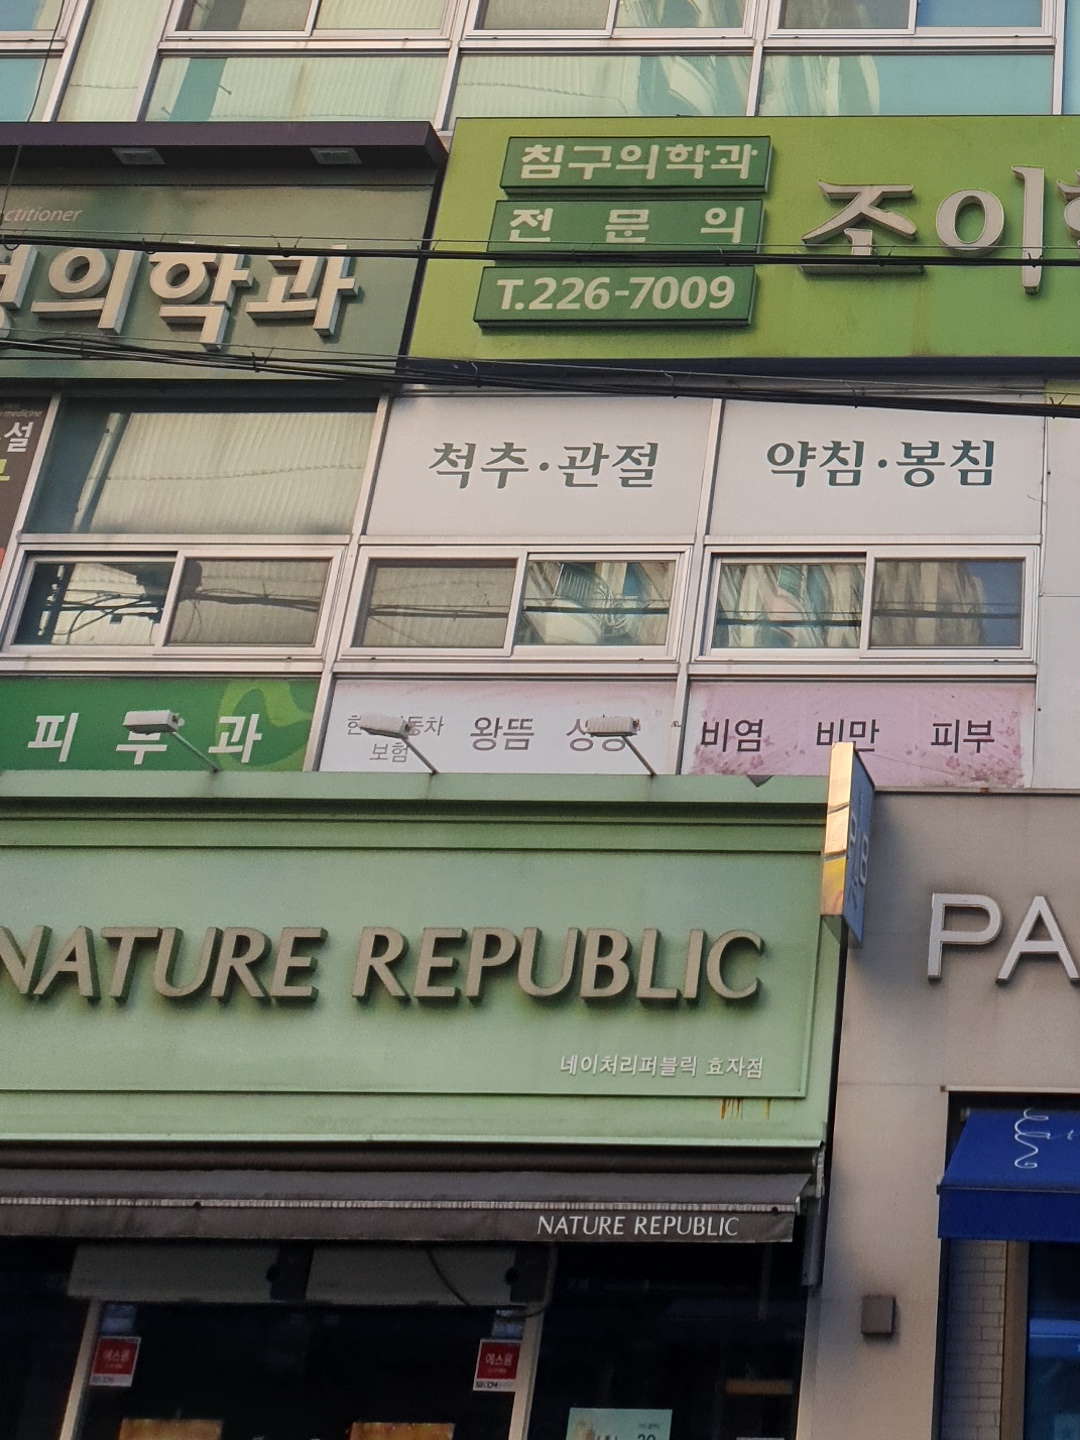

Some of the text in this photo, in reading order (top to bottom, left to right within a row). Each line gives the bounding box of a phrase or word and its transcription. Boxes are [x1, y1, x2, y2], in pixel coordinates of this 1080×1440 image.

[519, 143, 759, 181] 침구의학과
[496, 274, 737, 311] T.226-7009
[428, 440, 660, 490] 척추·관절
[766, 439, 995, 488] 약침·봉침
[469, 716, 535, 752] 왕뜸
[700, 718, 995, 754] 비염 비만 피부
[0, 925, 765, 1002] NATURE REPUBLIC
[559, 1053, 764, 1079] 네이처리퍼블릭 효자점
[536, 1214, 740, 1237] NATURE REPUBLIC
